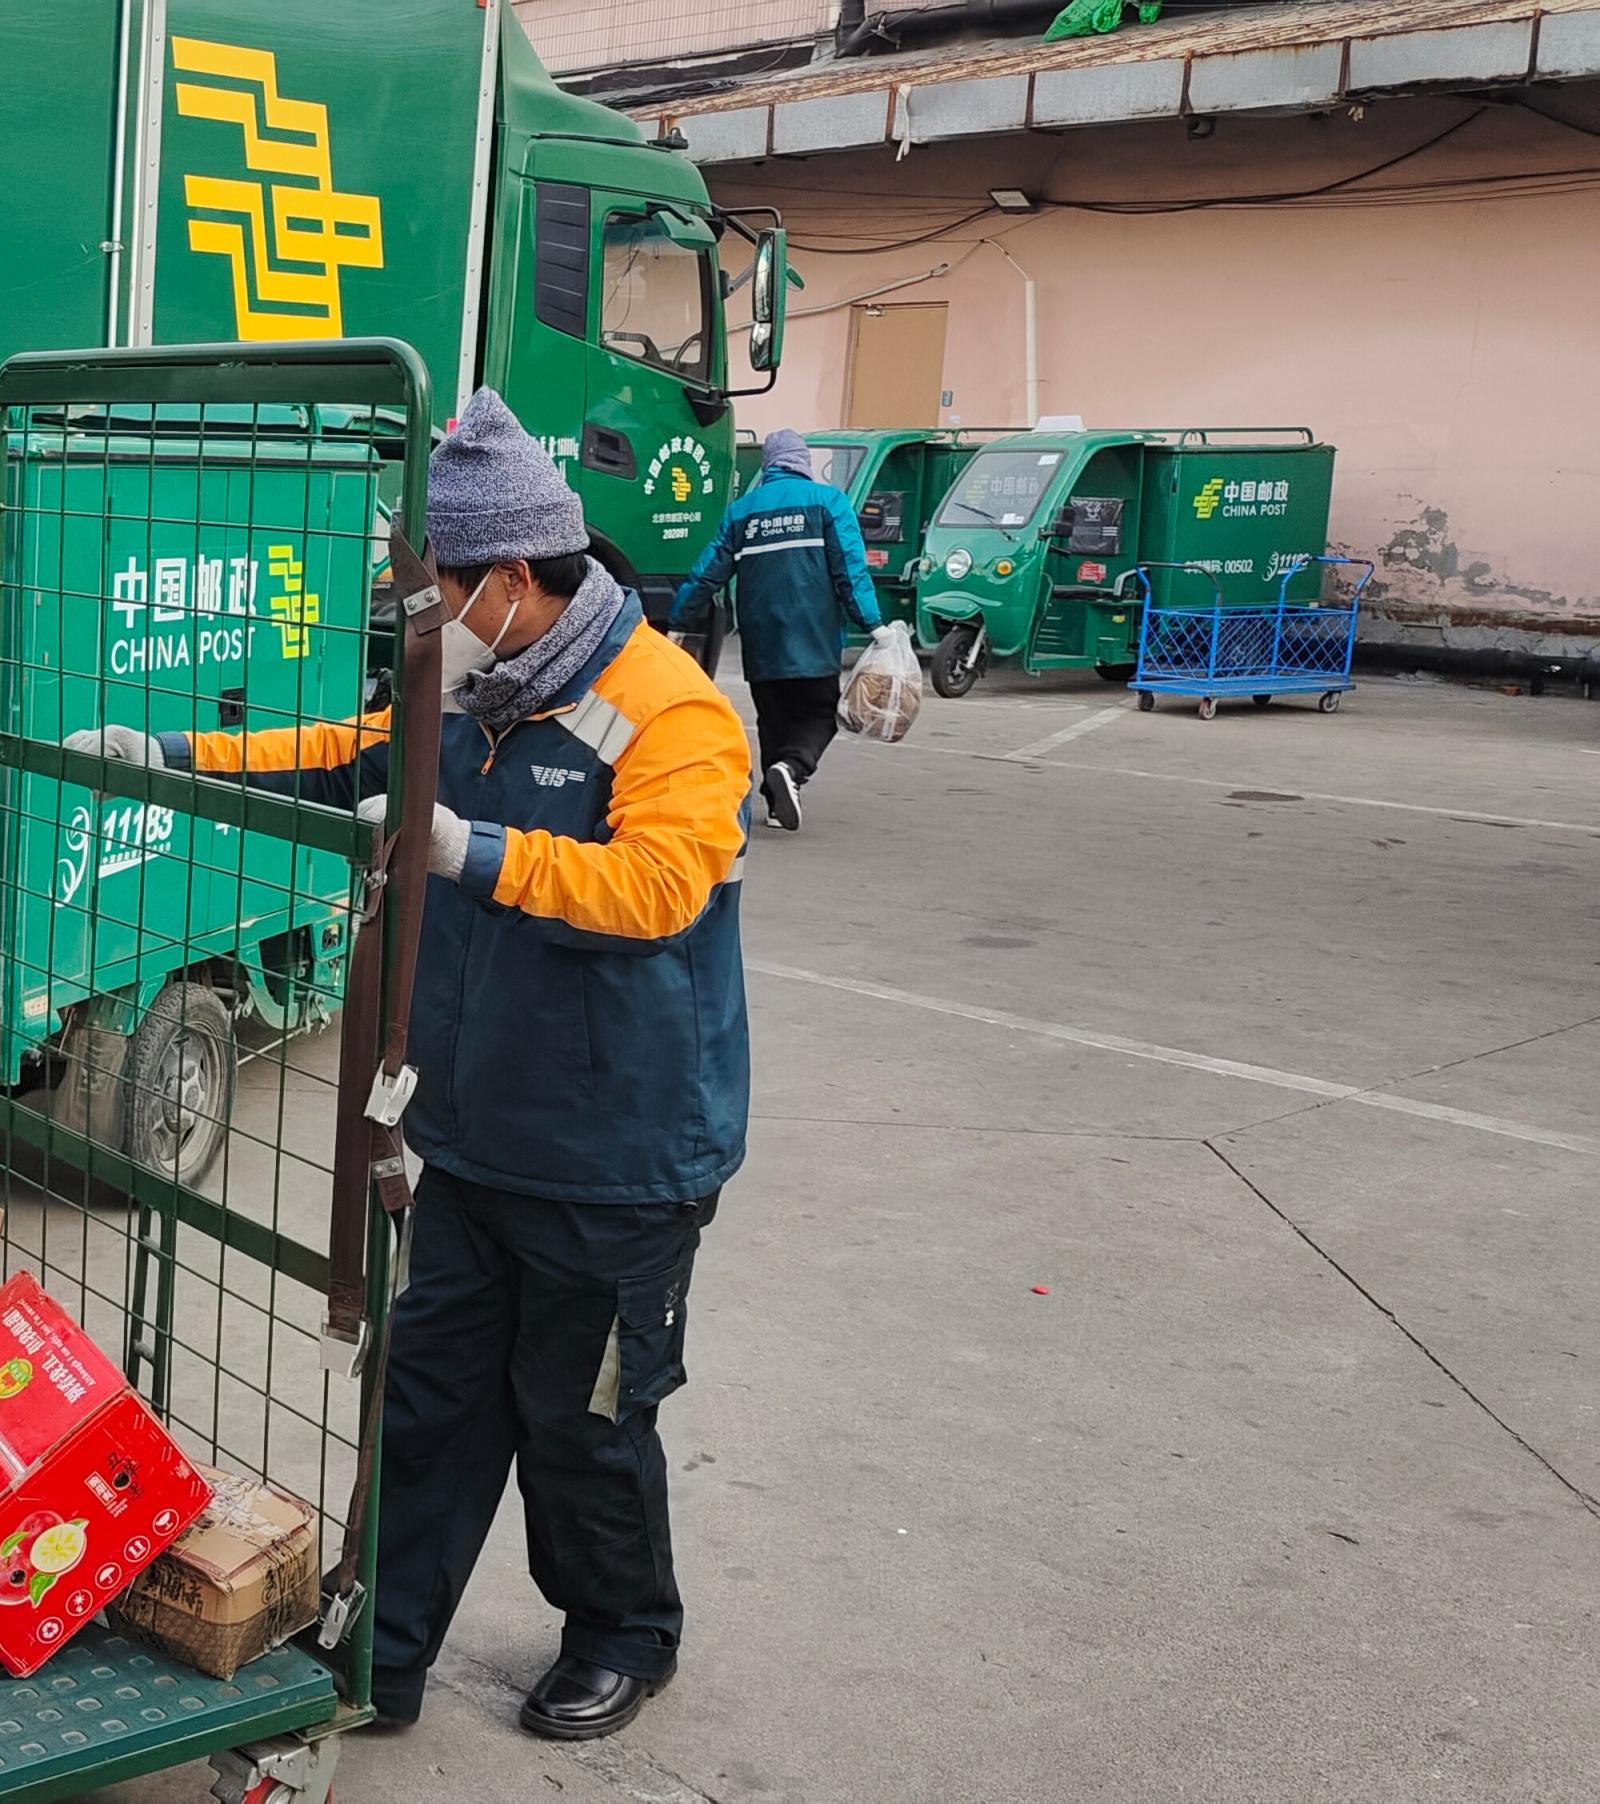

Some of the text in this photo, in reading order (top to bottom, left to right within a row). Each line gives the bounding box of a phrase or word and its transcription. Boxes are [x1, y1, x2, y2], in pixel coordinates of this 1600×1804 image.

[1223, 479, 1289, 503] 中国邮政
[760, 514, 805, 529] 中国邮政
[1222, 503, 1288, 518] CHINA POST
[761, 524, 805, 537] CHINA POST
[112, 552, 259, 629] 中国邮政
[110, 625, 256, 675] CHINA POST
[103, 803, 174, 853] 11183
